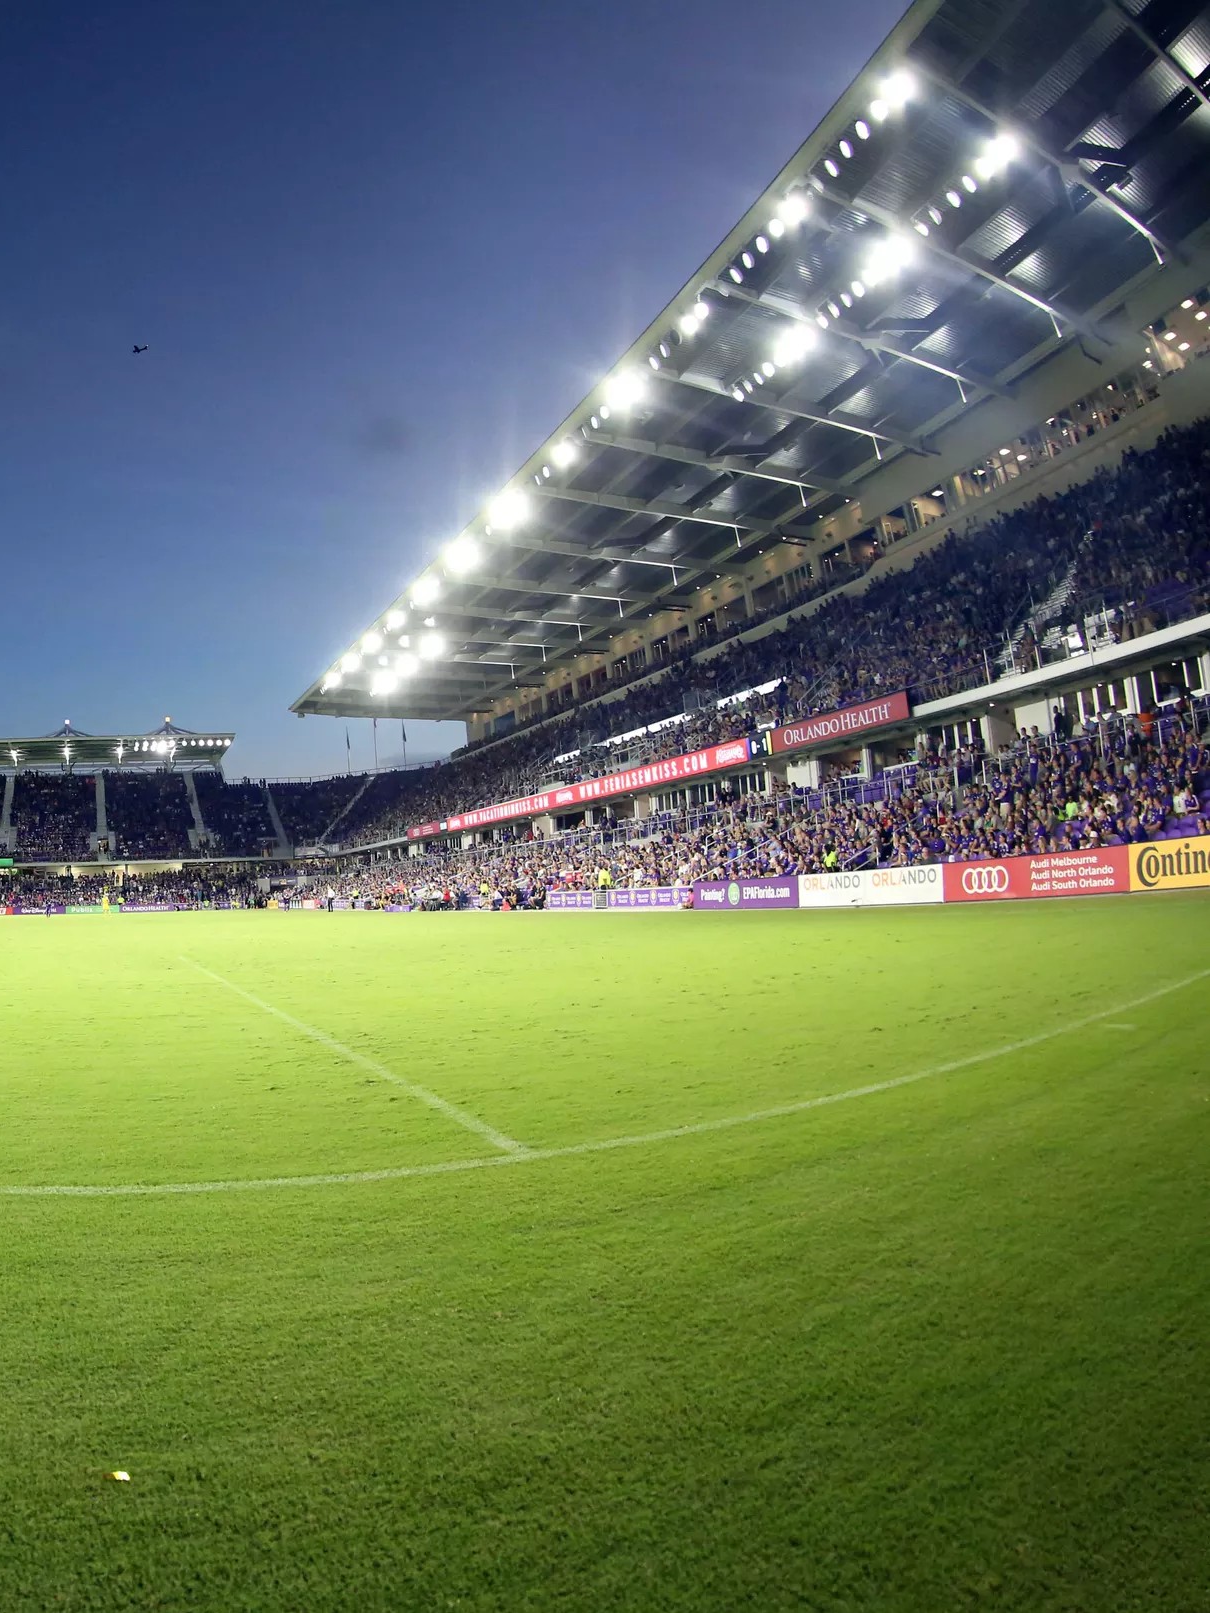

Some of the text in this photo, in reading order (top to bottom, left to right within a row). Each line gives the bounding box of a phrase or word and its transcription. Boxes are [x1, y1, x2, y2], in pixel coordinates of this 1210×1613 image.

[783, 703, 890, 745] ORLANDO HEALTH
[579, 752, 709, 799] WWW.FERIASEMKISS.COM
[1030, 855, 1098, 869] Audi Melbourne
[1136, 843, 1210, 887] Contin
[871, 868, 937, 887] ORLANDO
[1030, 865, 1114, 880] Audi North Orlando
[803, 874, 861, 891] ORLANDO
[1031, 877, 1115, 891] Audi South Orlando
[700, 888, 725, 903] Painting?
[742, 885, 790, 900] EPAFlorida.com
